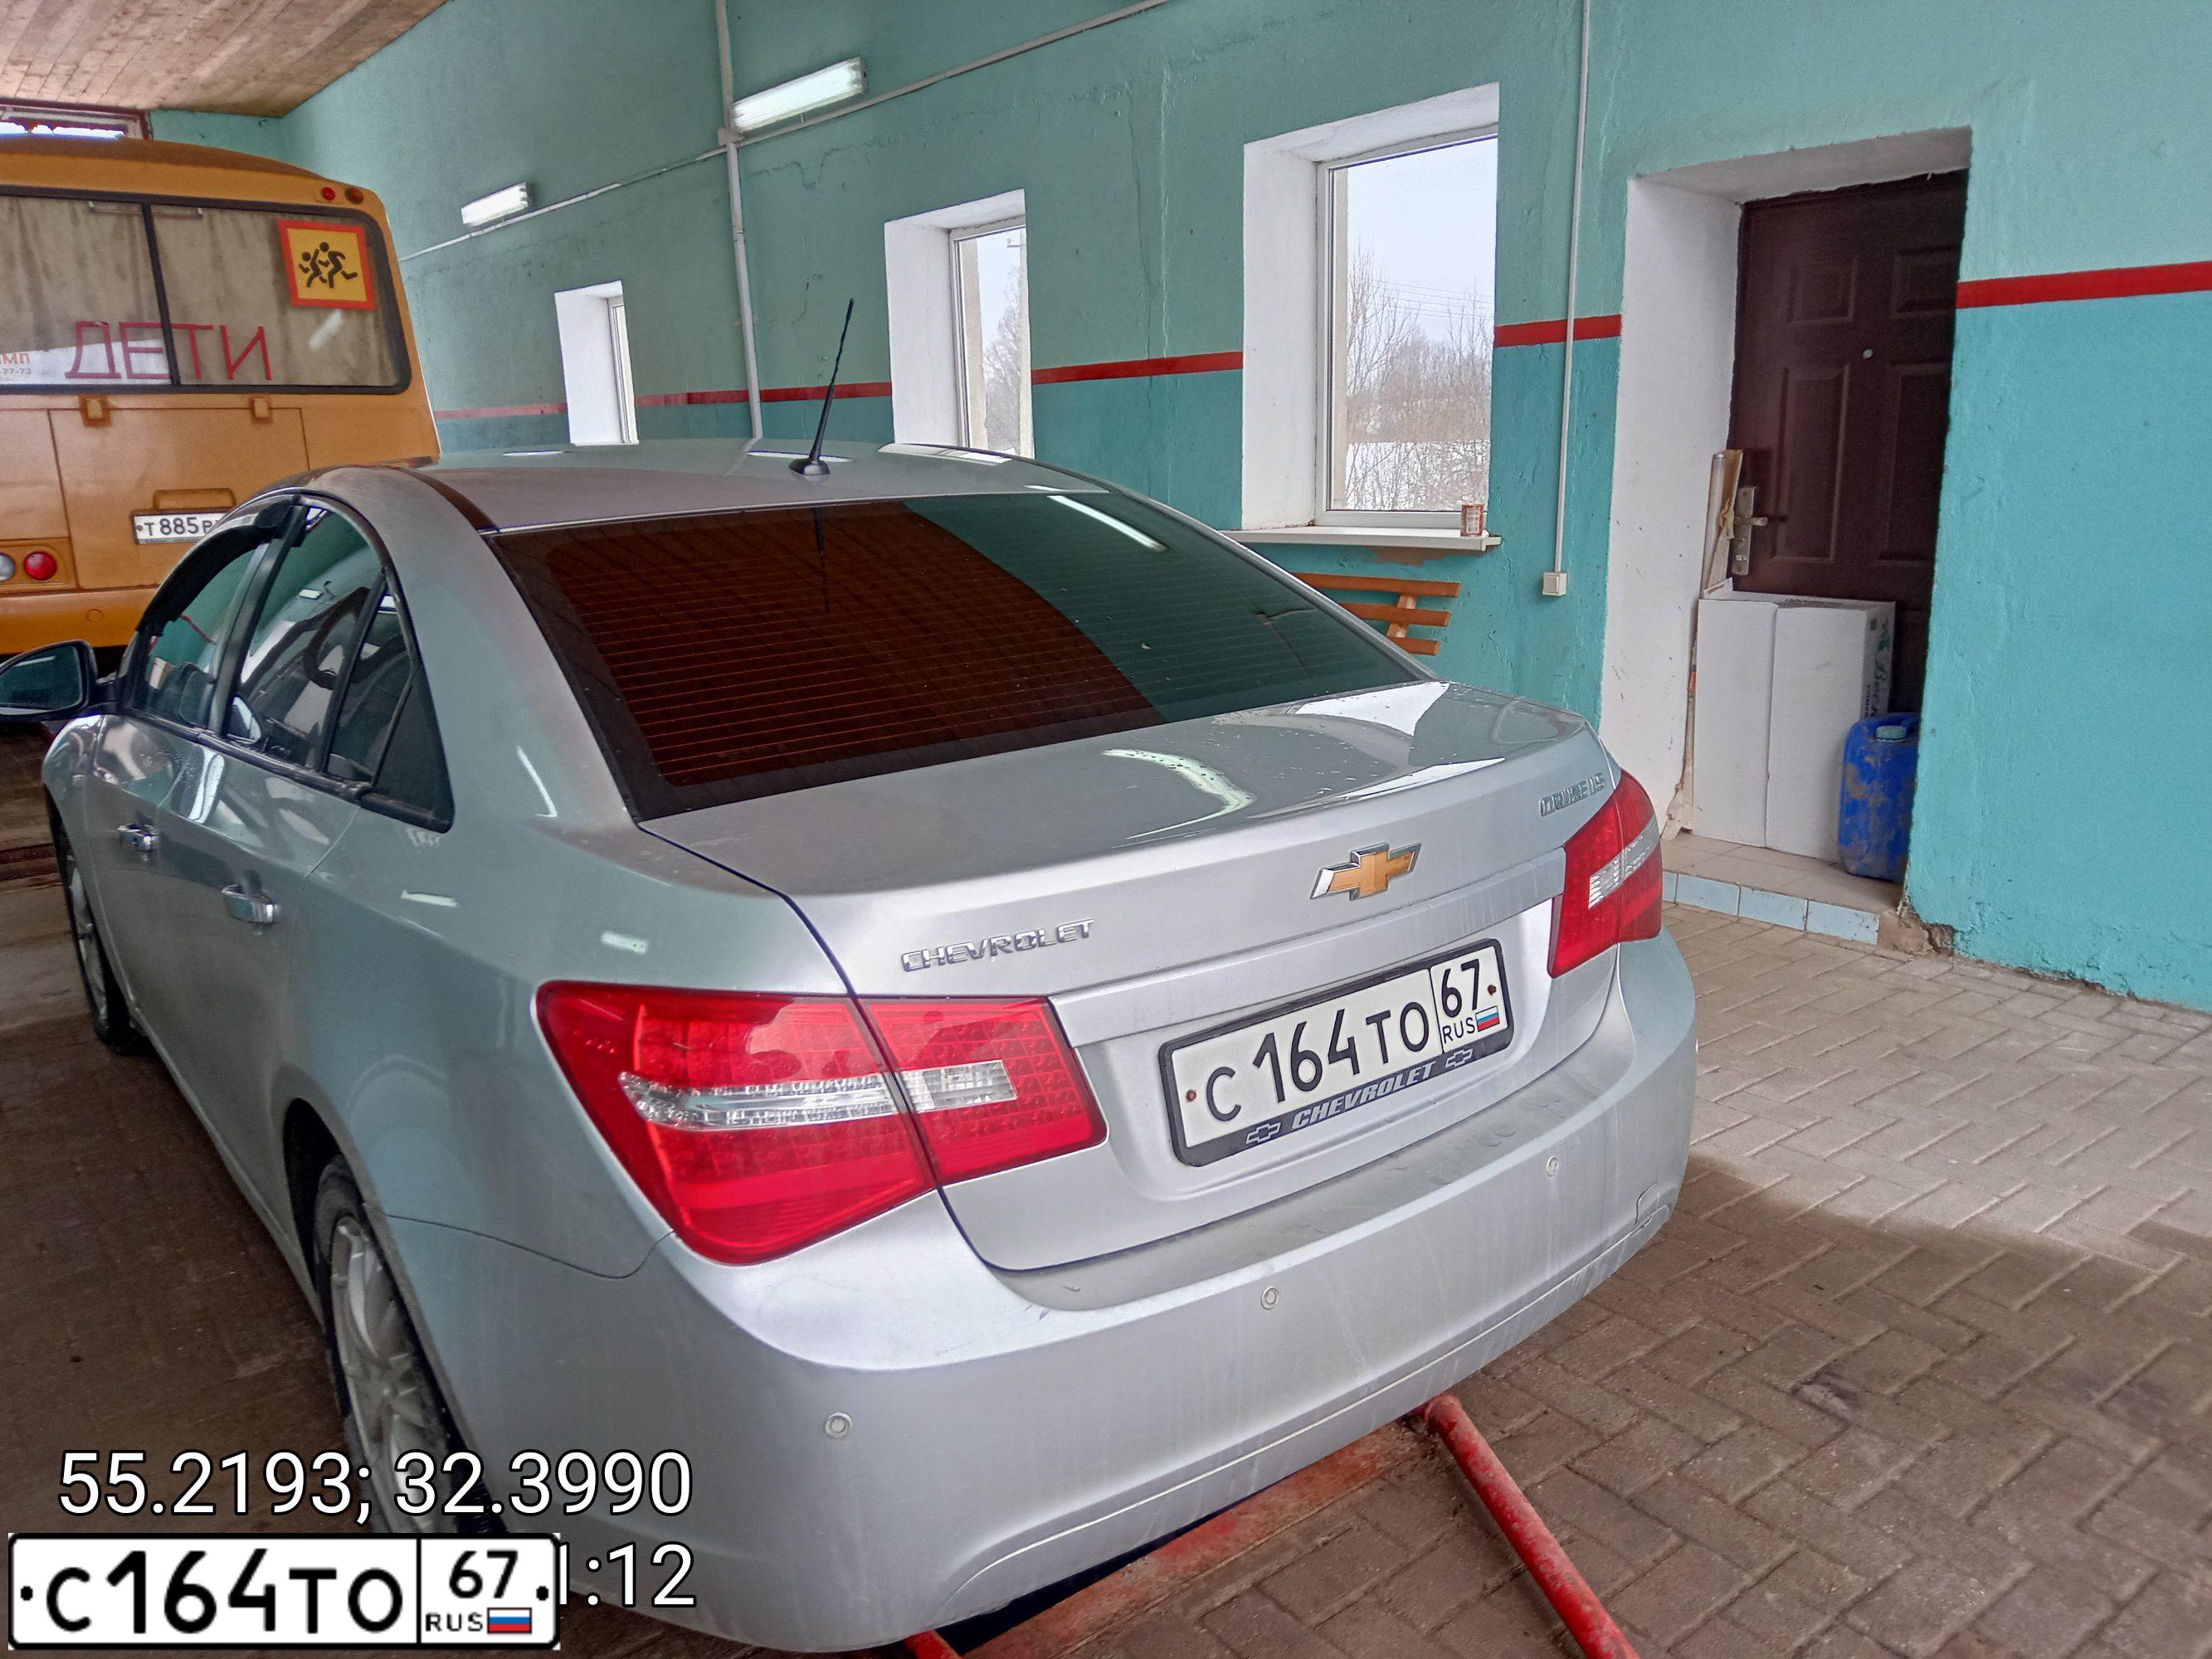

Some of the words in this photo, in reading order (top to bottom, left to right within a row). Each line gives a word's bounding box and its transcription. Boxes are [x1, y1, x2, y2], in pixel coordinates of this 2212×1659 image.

[65, 320, 272, 380] ДЕТИ
[144, 516, 218, 536] Т885Р
[901, 917, 1094, 972] CHEVROLET
[1440, 959, 1479, 1018] 67
[1442, 1018, 1476, 1044] RUS
[1206, 1001, 1429, 1121] С164ТО
[1291, 1061, 1435, 1131] CHEVROLET
